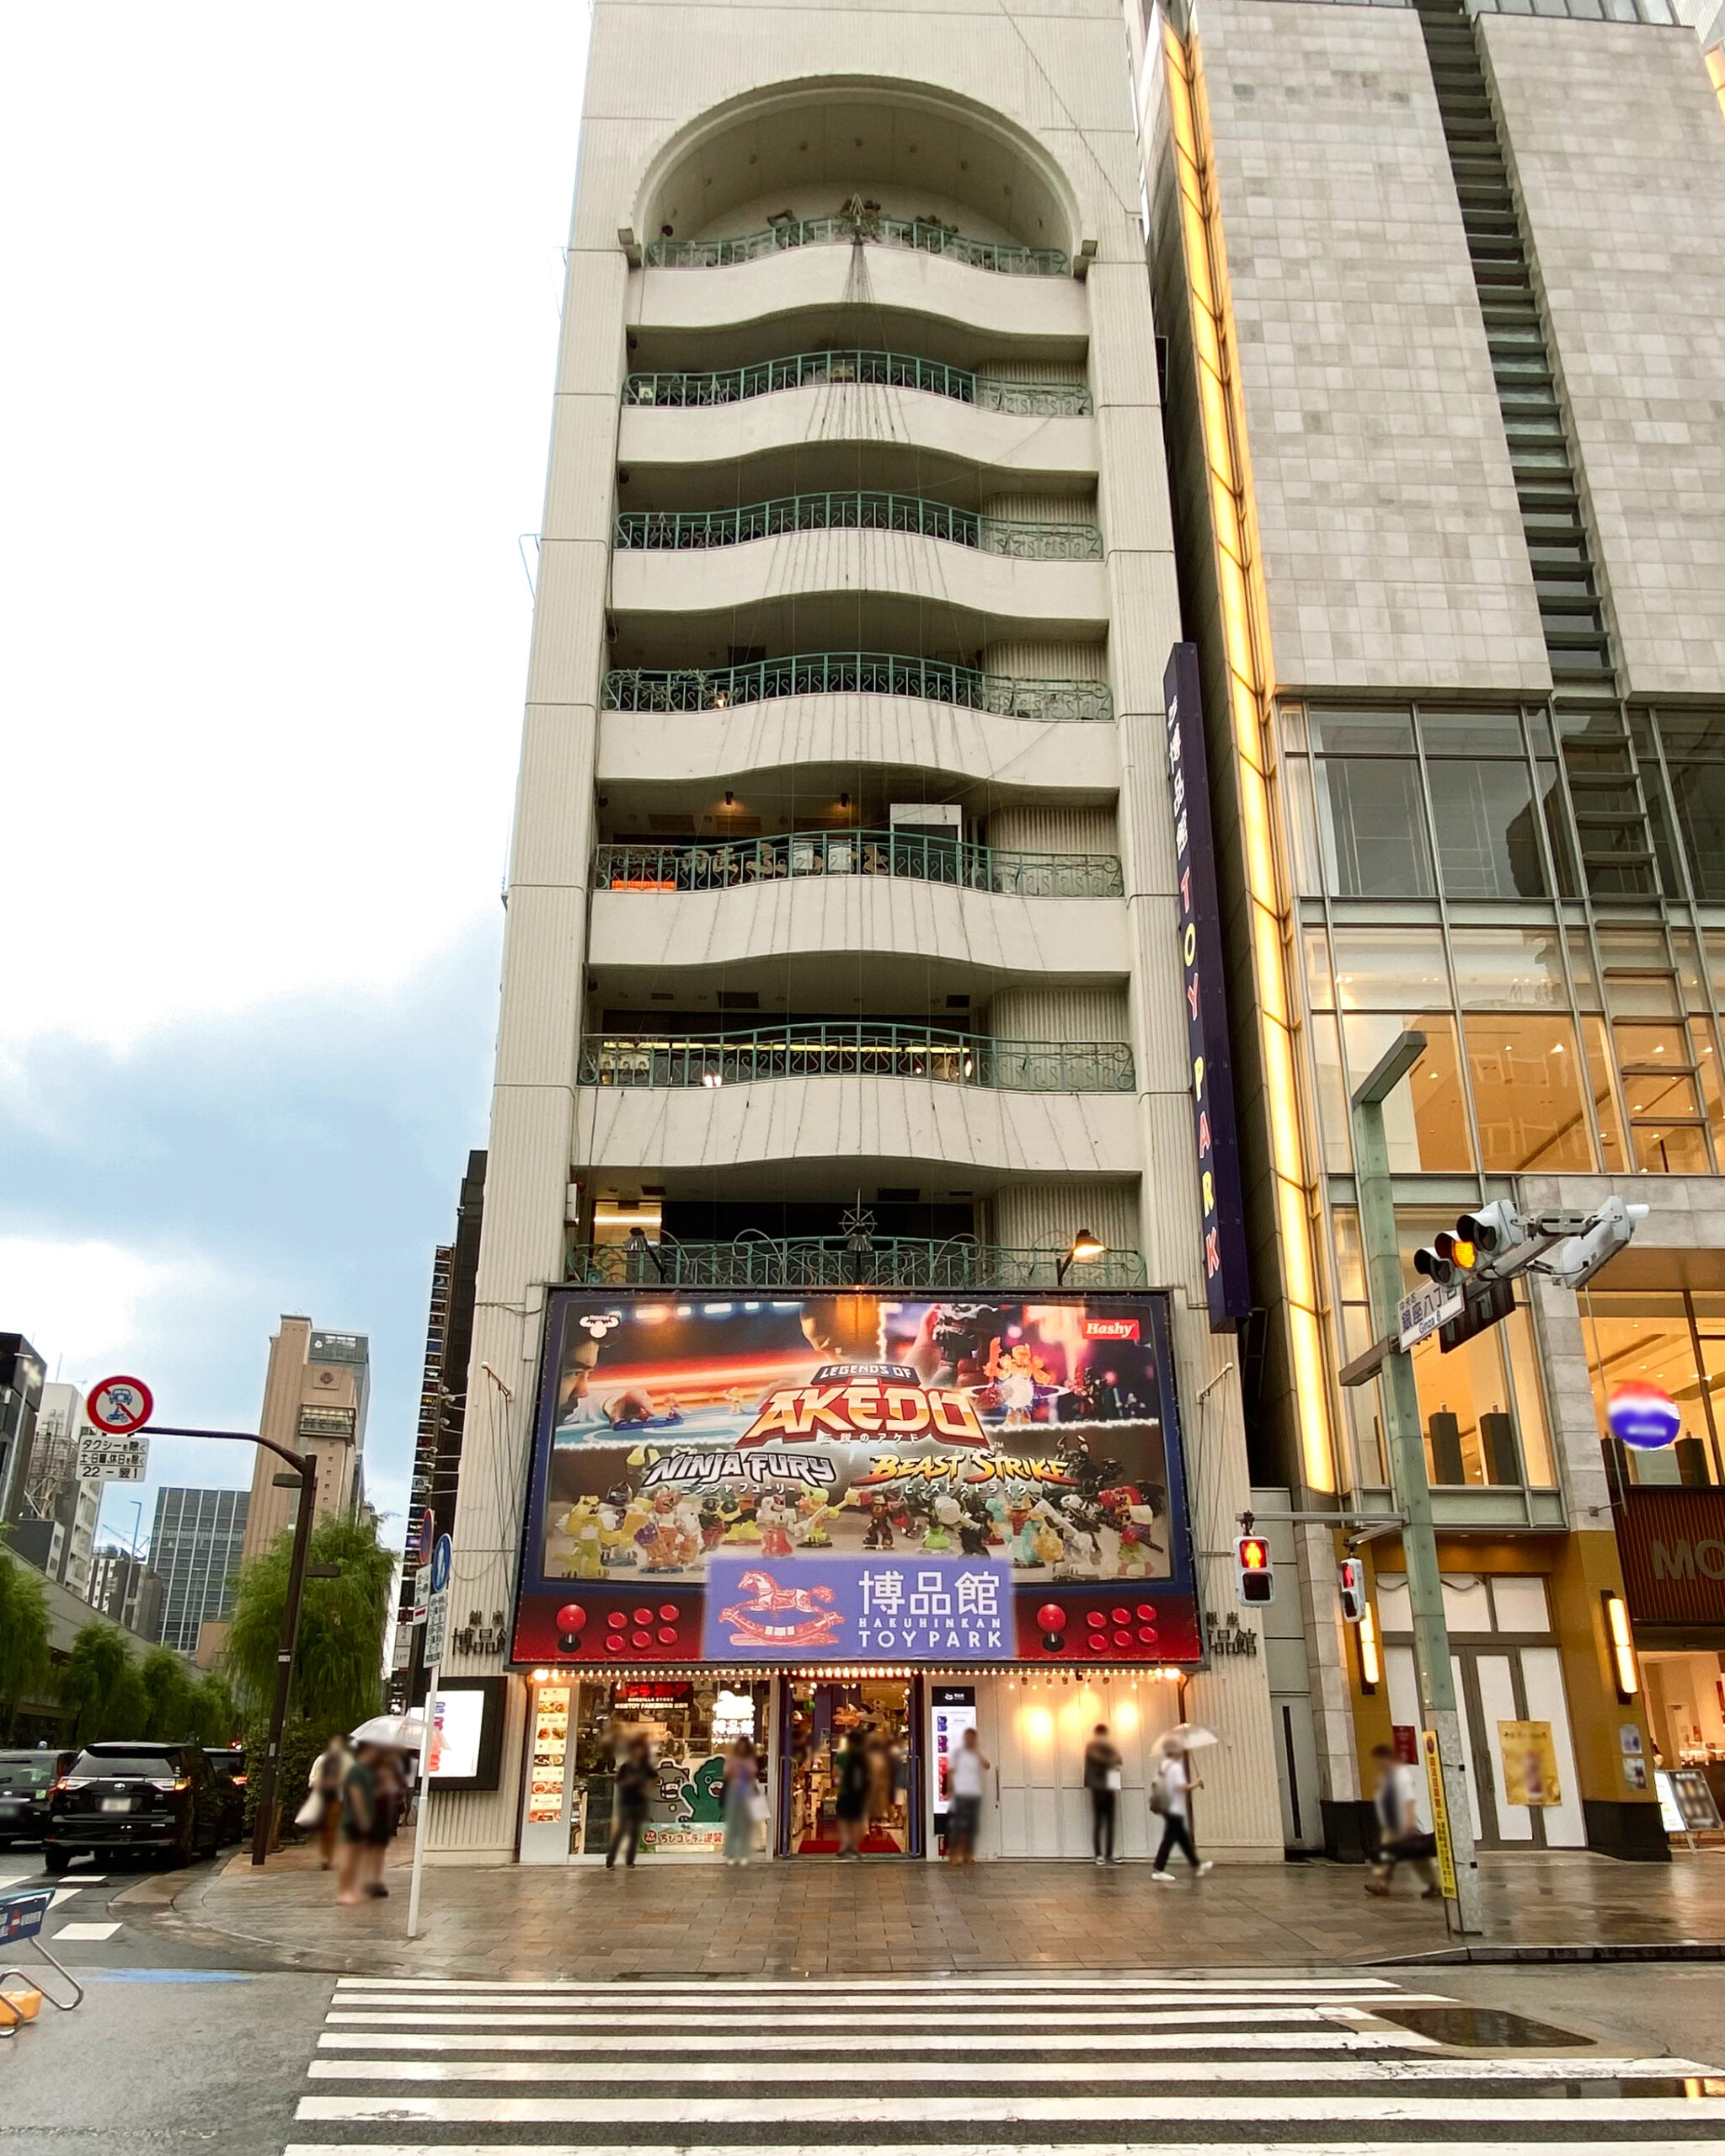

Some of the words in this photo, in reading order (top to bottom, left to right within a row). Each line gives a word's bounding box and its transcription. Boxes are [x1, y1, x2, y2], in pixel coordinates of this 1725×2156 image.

[1180, 865, 1199, 1021] TOY
[1194, 1055, 1220, 1278] PARK
[1086, 1321, 1134, 1338] Hashy
[1418, 1317, 1434, 1333] Ginza
[1436, 1310, 1441, 1322] 8
[820, 1364, 889, 1380] LEGENDS
[893, 1365, 912, 1380] OF
[741, 1379, 984, 1440] AKEDO
[643, 1453, 744, 1486] NINJA
[745, 1453, 836, 1486] FURY
[861, 1454, 966, 1486] BEAST
[967, 1449, 1072, 1486] STRIKE
[858, 1570, 1000, 1615] 博品館
[858, 1618, 1001, 1628] HAKUHINKAN
[858, 1630, 917, 1648] TOY
[928, 1630, 1002, 1648] PARK
[1206, 1628, 1258, 1656] 品館
